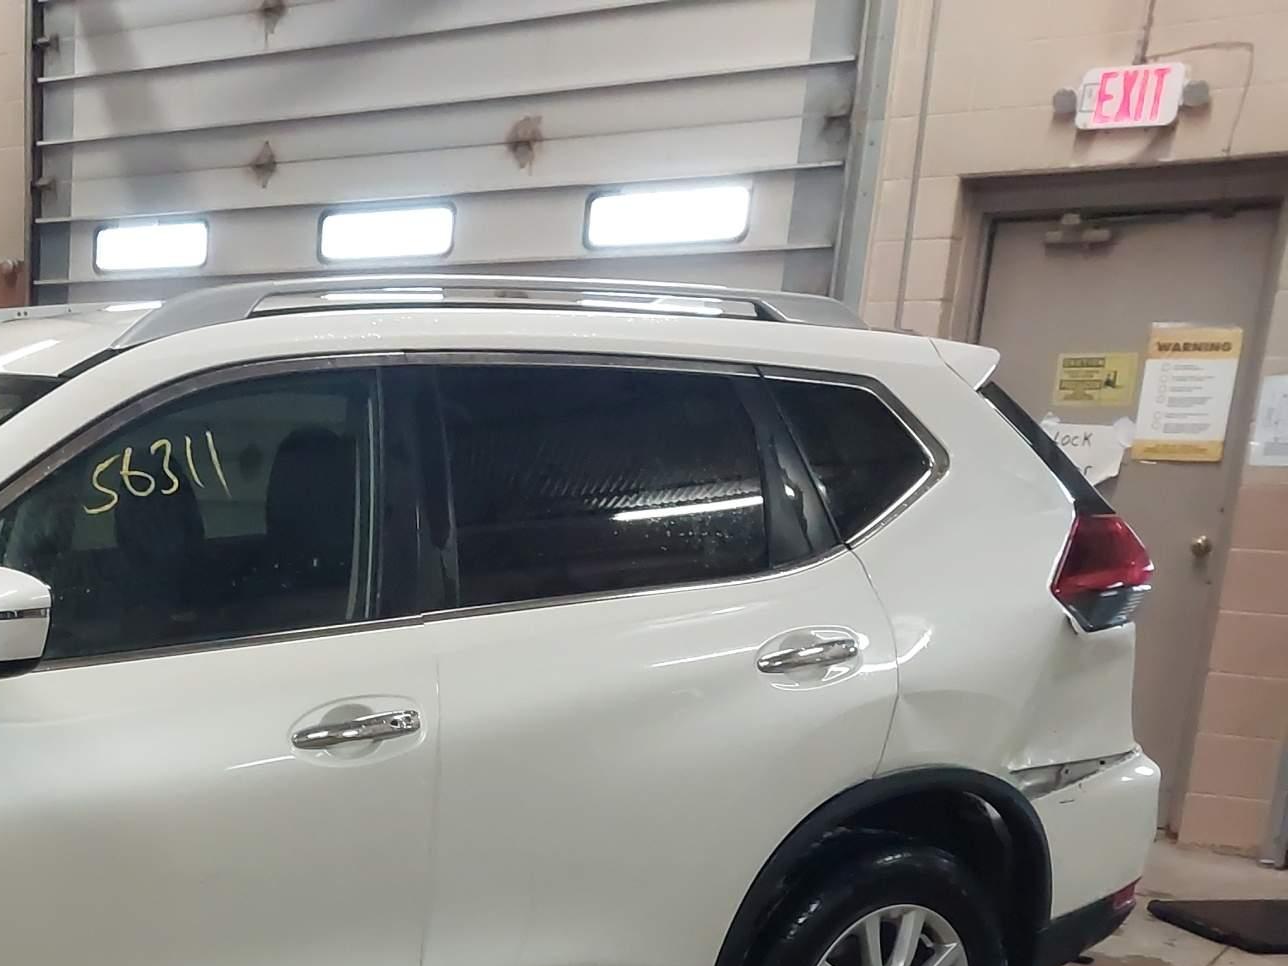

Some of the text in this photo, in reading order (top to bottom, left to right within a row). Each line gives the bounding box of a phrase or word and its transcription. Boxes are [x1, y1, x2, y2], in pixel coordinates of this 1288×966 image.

[1092, 67, 1171, 123] EXIT
[1155, 341, 1232, 353] WARNING
[82, 430, 233, 514] 56311
